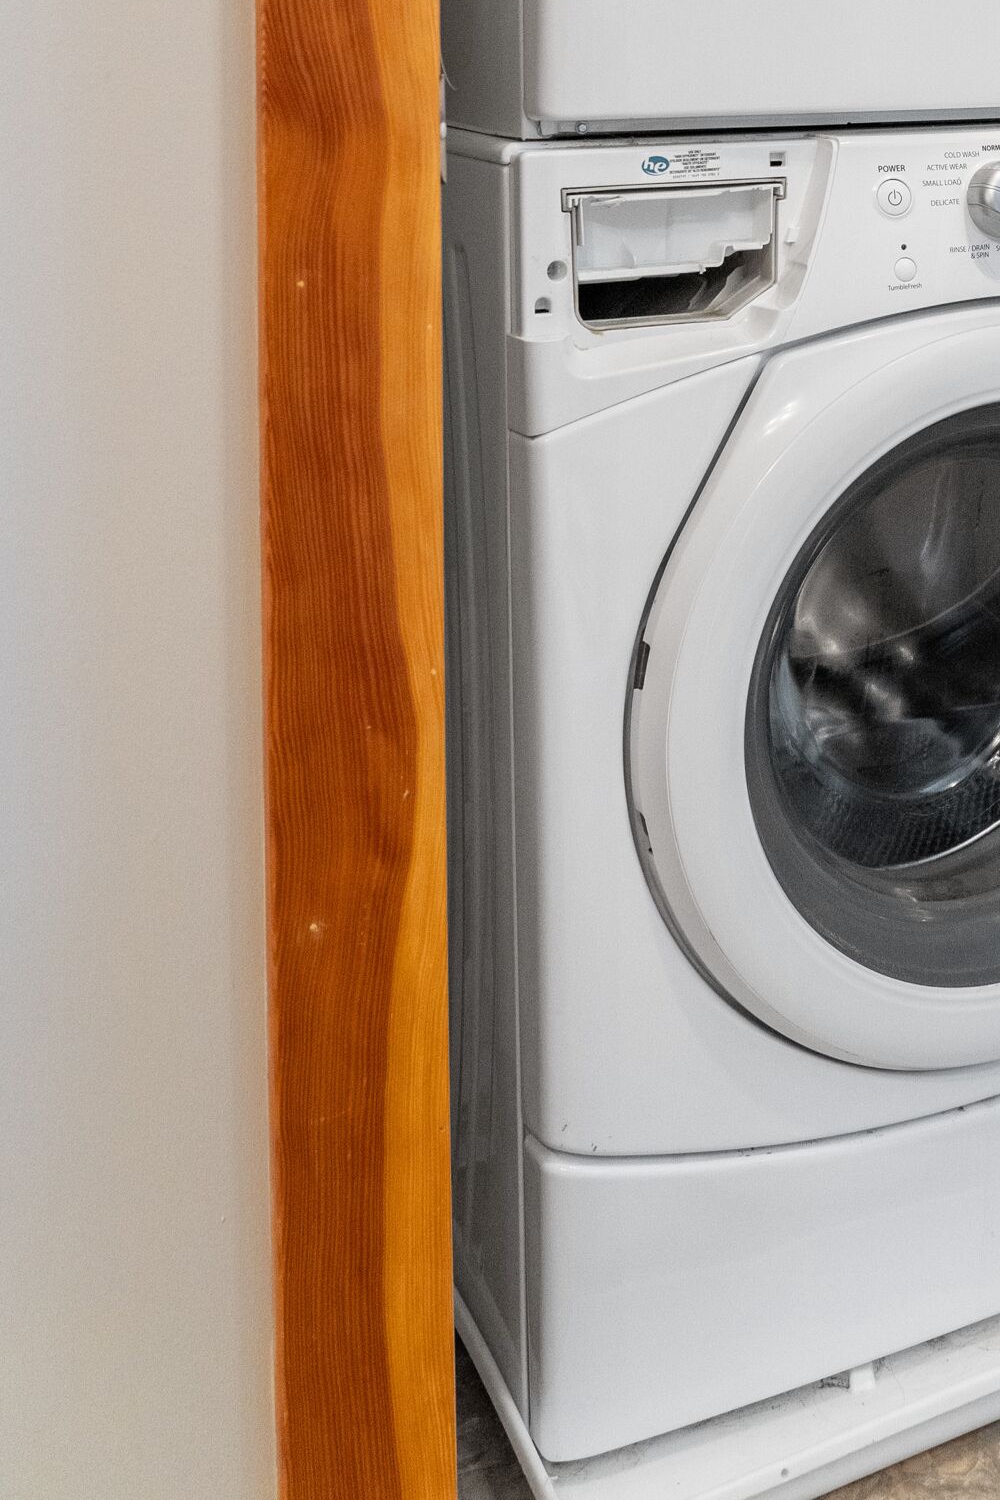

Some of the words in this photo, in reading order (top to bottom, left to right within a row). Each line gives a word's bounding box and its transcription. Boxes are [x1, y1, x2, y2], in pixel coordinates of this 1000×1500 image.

[642, 157, 668, 174] he
[878, 164, 906, 172] POWER
[930, 199, 960, 207] DELICATE
[888, 282, 922, 291] TumbleFresh
